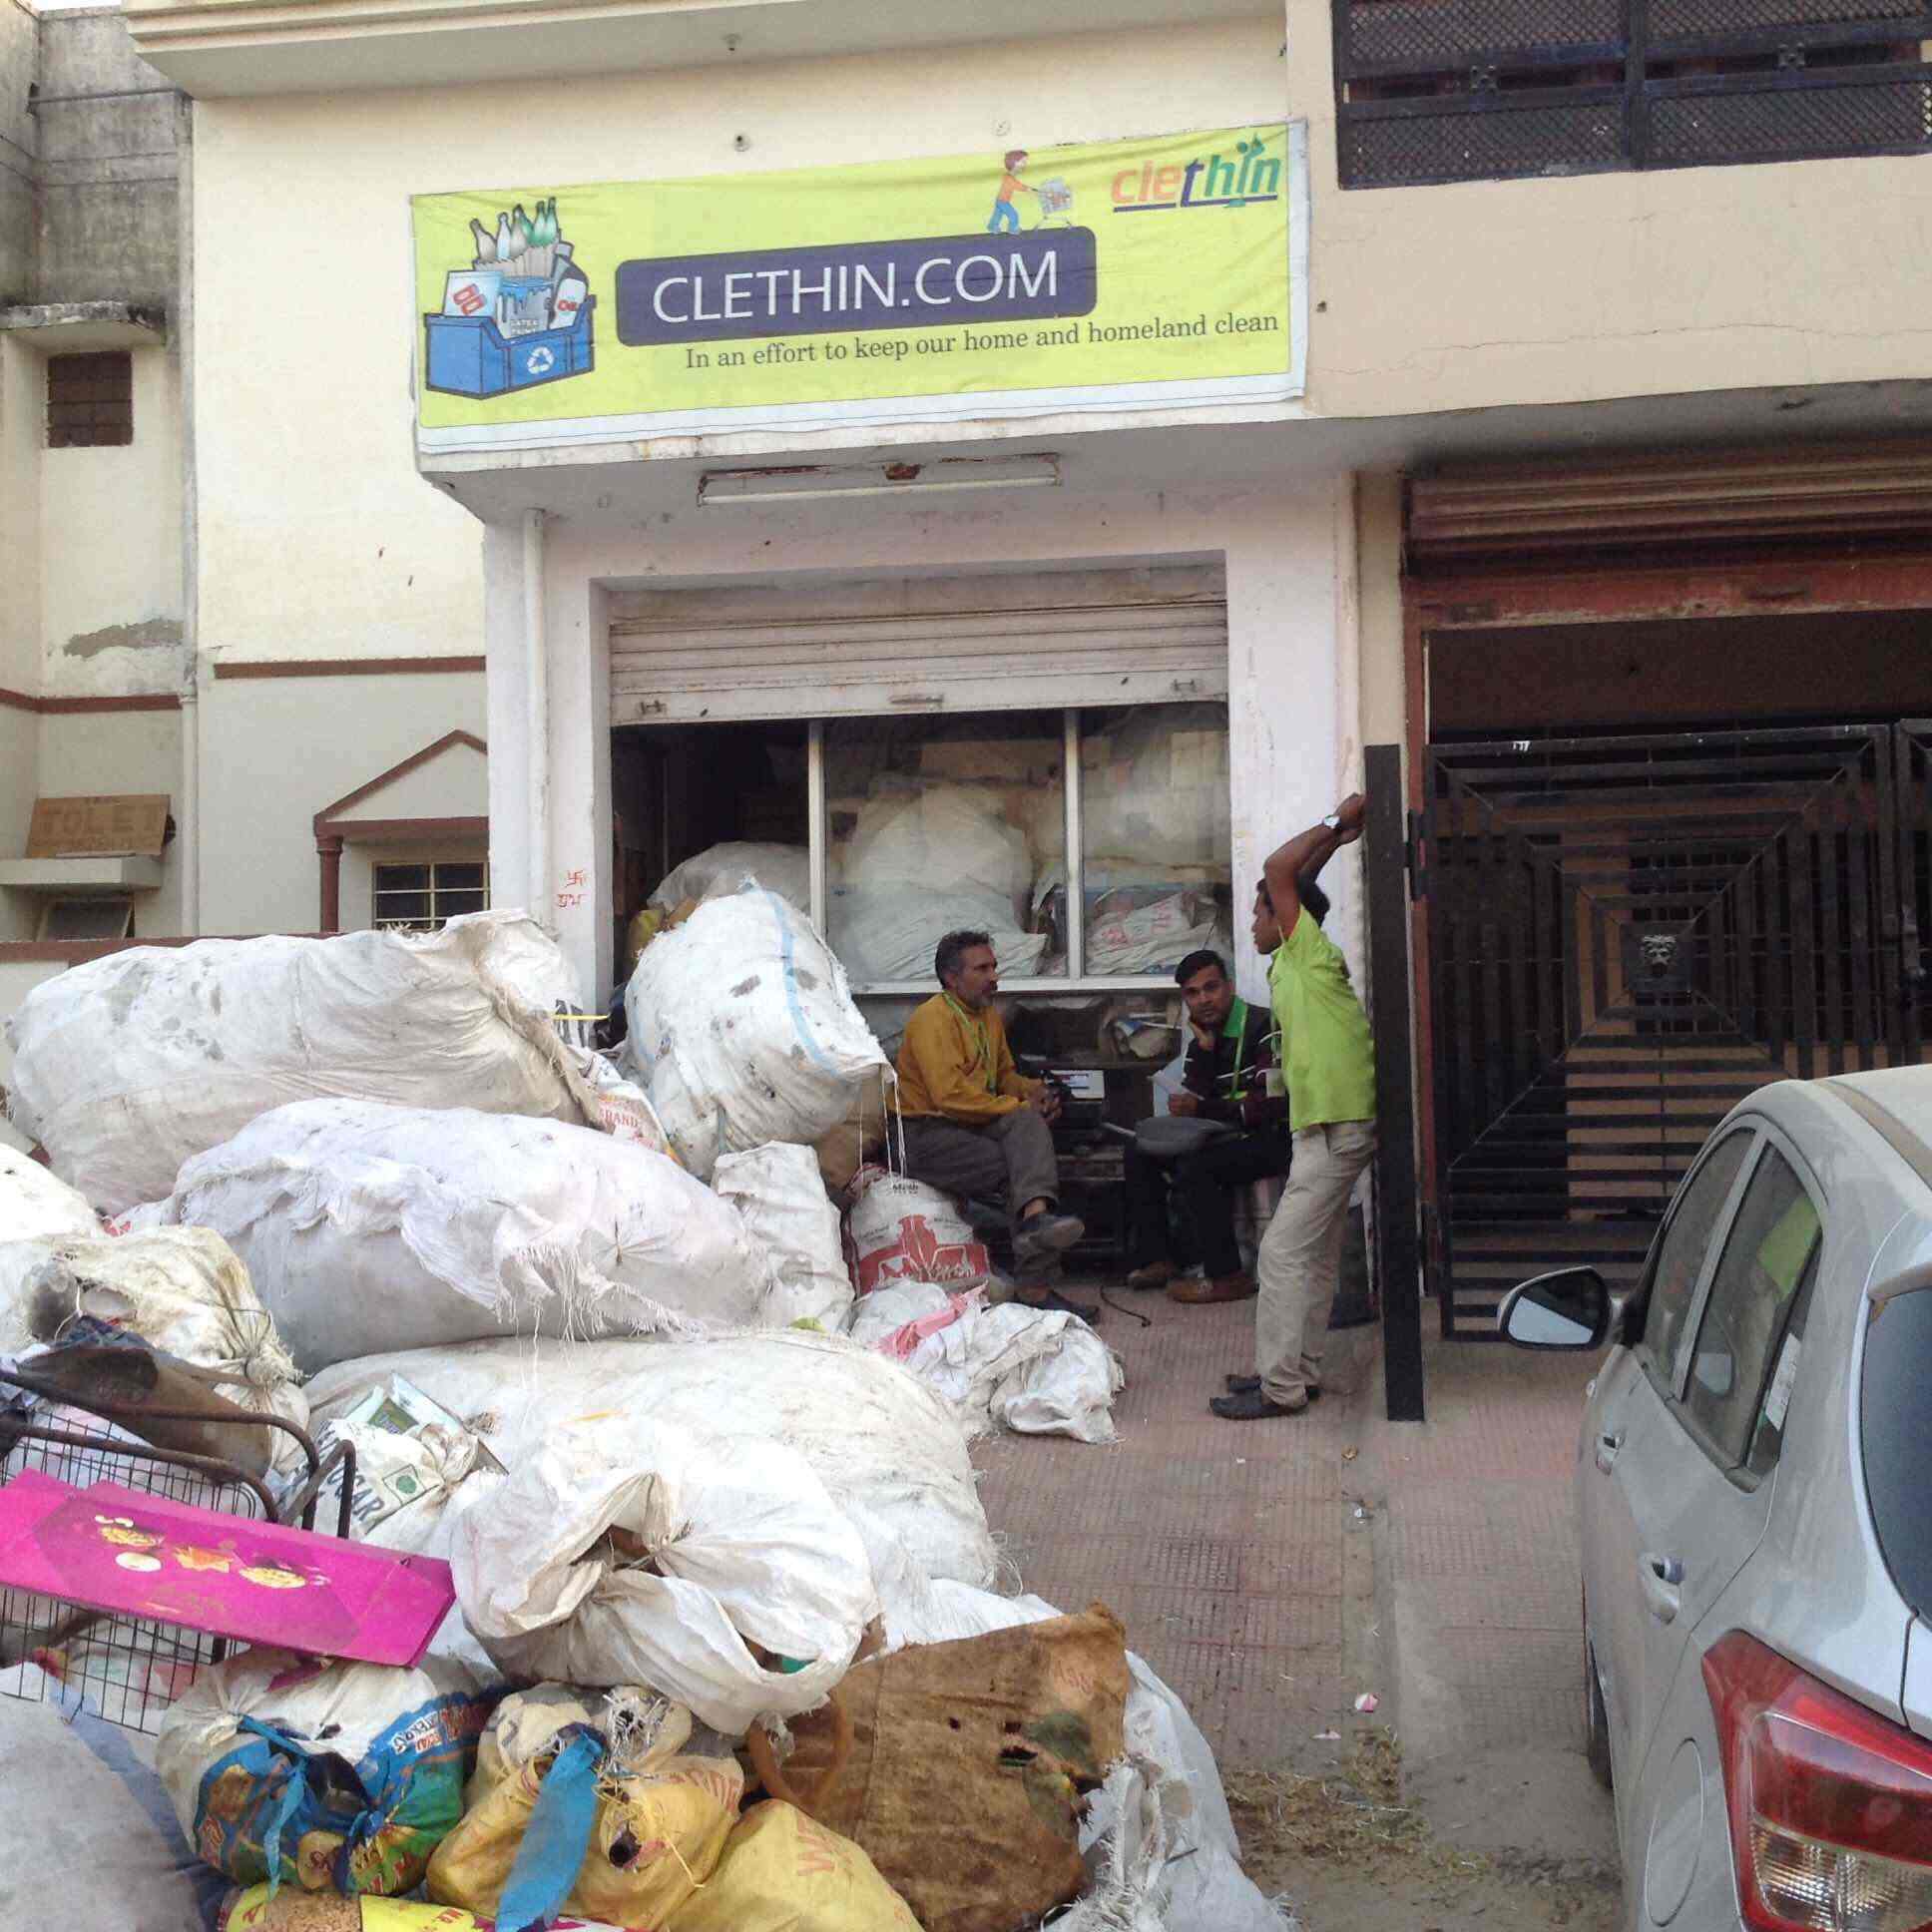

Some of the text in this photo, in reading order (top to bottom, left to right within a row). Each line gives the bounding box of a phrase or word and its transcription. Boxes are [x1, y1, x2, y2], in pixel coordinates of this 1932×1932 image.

[1112, 133, 1281, 208] clethin
[653, 249, 1058, 324] CLETHIN.COM
[686, 311, 1279, 368] In an effort to keep our home and homeland clean
